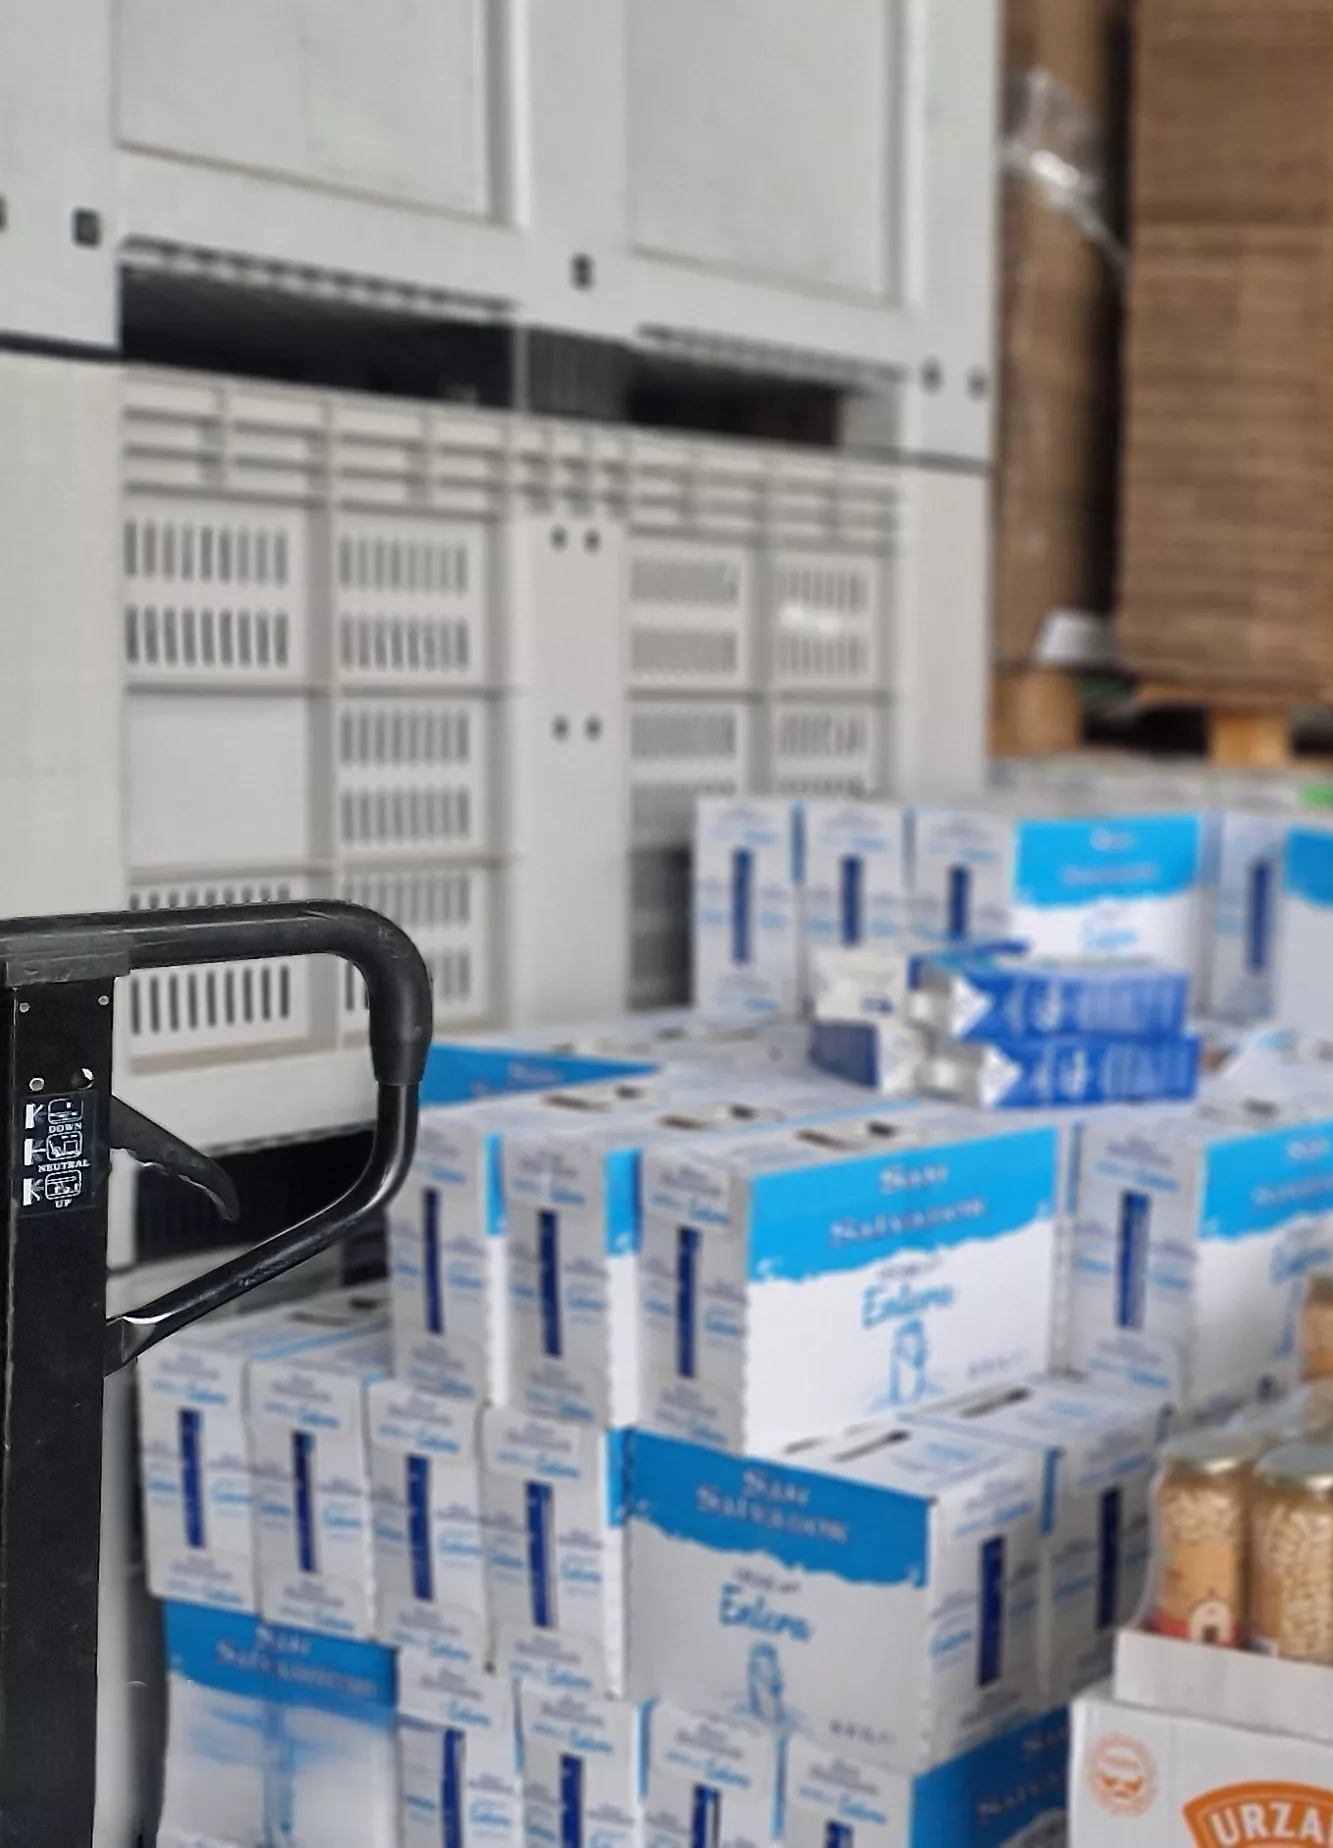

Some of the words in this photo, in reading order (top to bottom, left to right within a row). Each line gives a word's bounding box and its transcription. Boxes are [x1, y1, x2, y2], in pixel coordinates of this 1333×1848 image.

[48, 1122, 82, 1133] DOWN
[38, 1159, 91, 1173] NEUTRAL
[54, 1199, 72, 1209] UP
